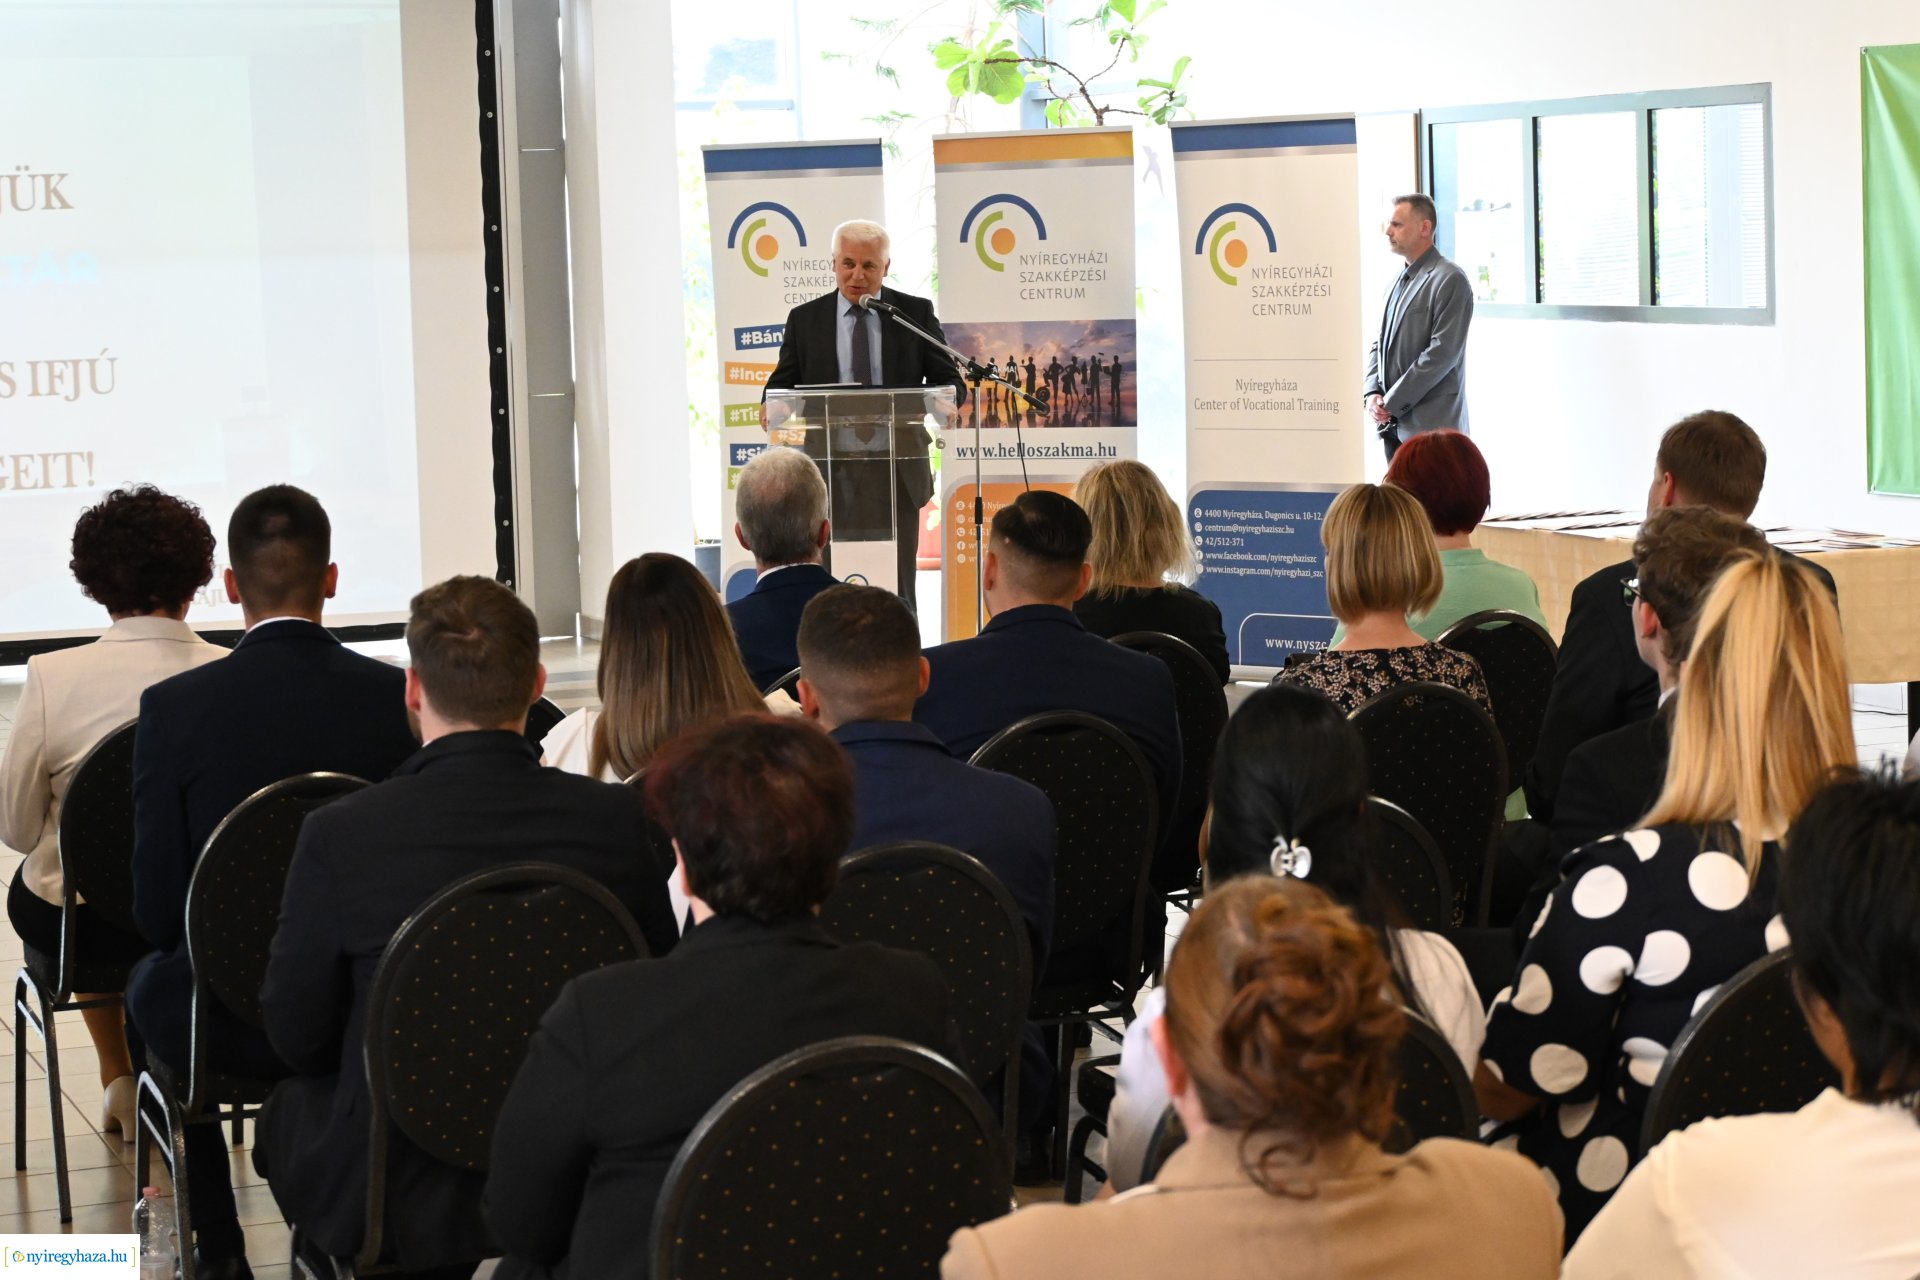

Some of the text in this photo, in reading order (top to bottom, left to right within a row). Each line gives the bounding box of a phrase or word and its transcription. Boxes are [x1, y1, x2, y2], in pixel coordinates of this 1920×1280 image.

[0, 164, 75, 213] ÜK
[1019, 250, 1108, 266] NYÍREGYHÁZI
[1019, 268, 1106, 283] SZAKKÉPZÉSI
[1251, 264, 1333, 279] NYÍREGYHÁZI
[1019, 287, 1086, 300] CENTRUM
[1251, 282, 1331, 298] SZAKKÉPZÉSI
[1252, 303, 1312, 316] CENTRUM
[26, 347, 118, 402] IFJÚ
[1235, 378, 1298, 394] Nyíregyháza
[1194, 398, 1340, 414] Center of Vocational Training
[1204, 509, 1221, 518] 4400
[1222, 509, 1263, 521] Nyíregyháza,
[1264, 510, 1294, 521] Dugonics
[1205, 537, 1245, 547] 42/512-371
